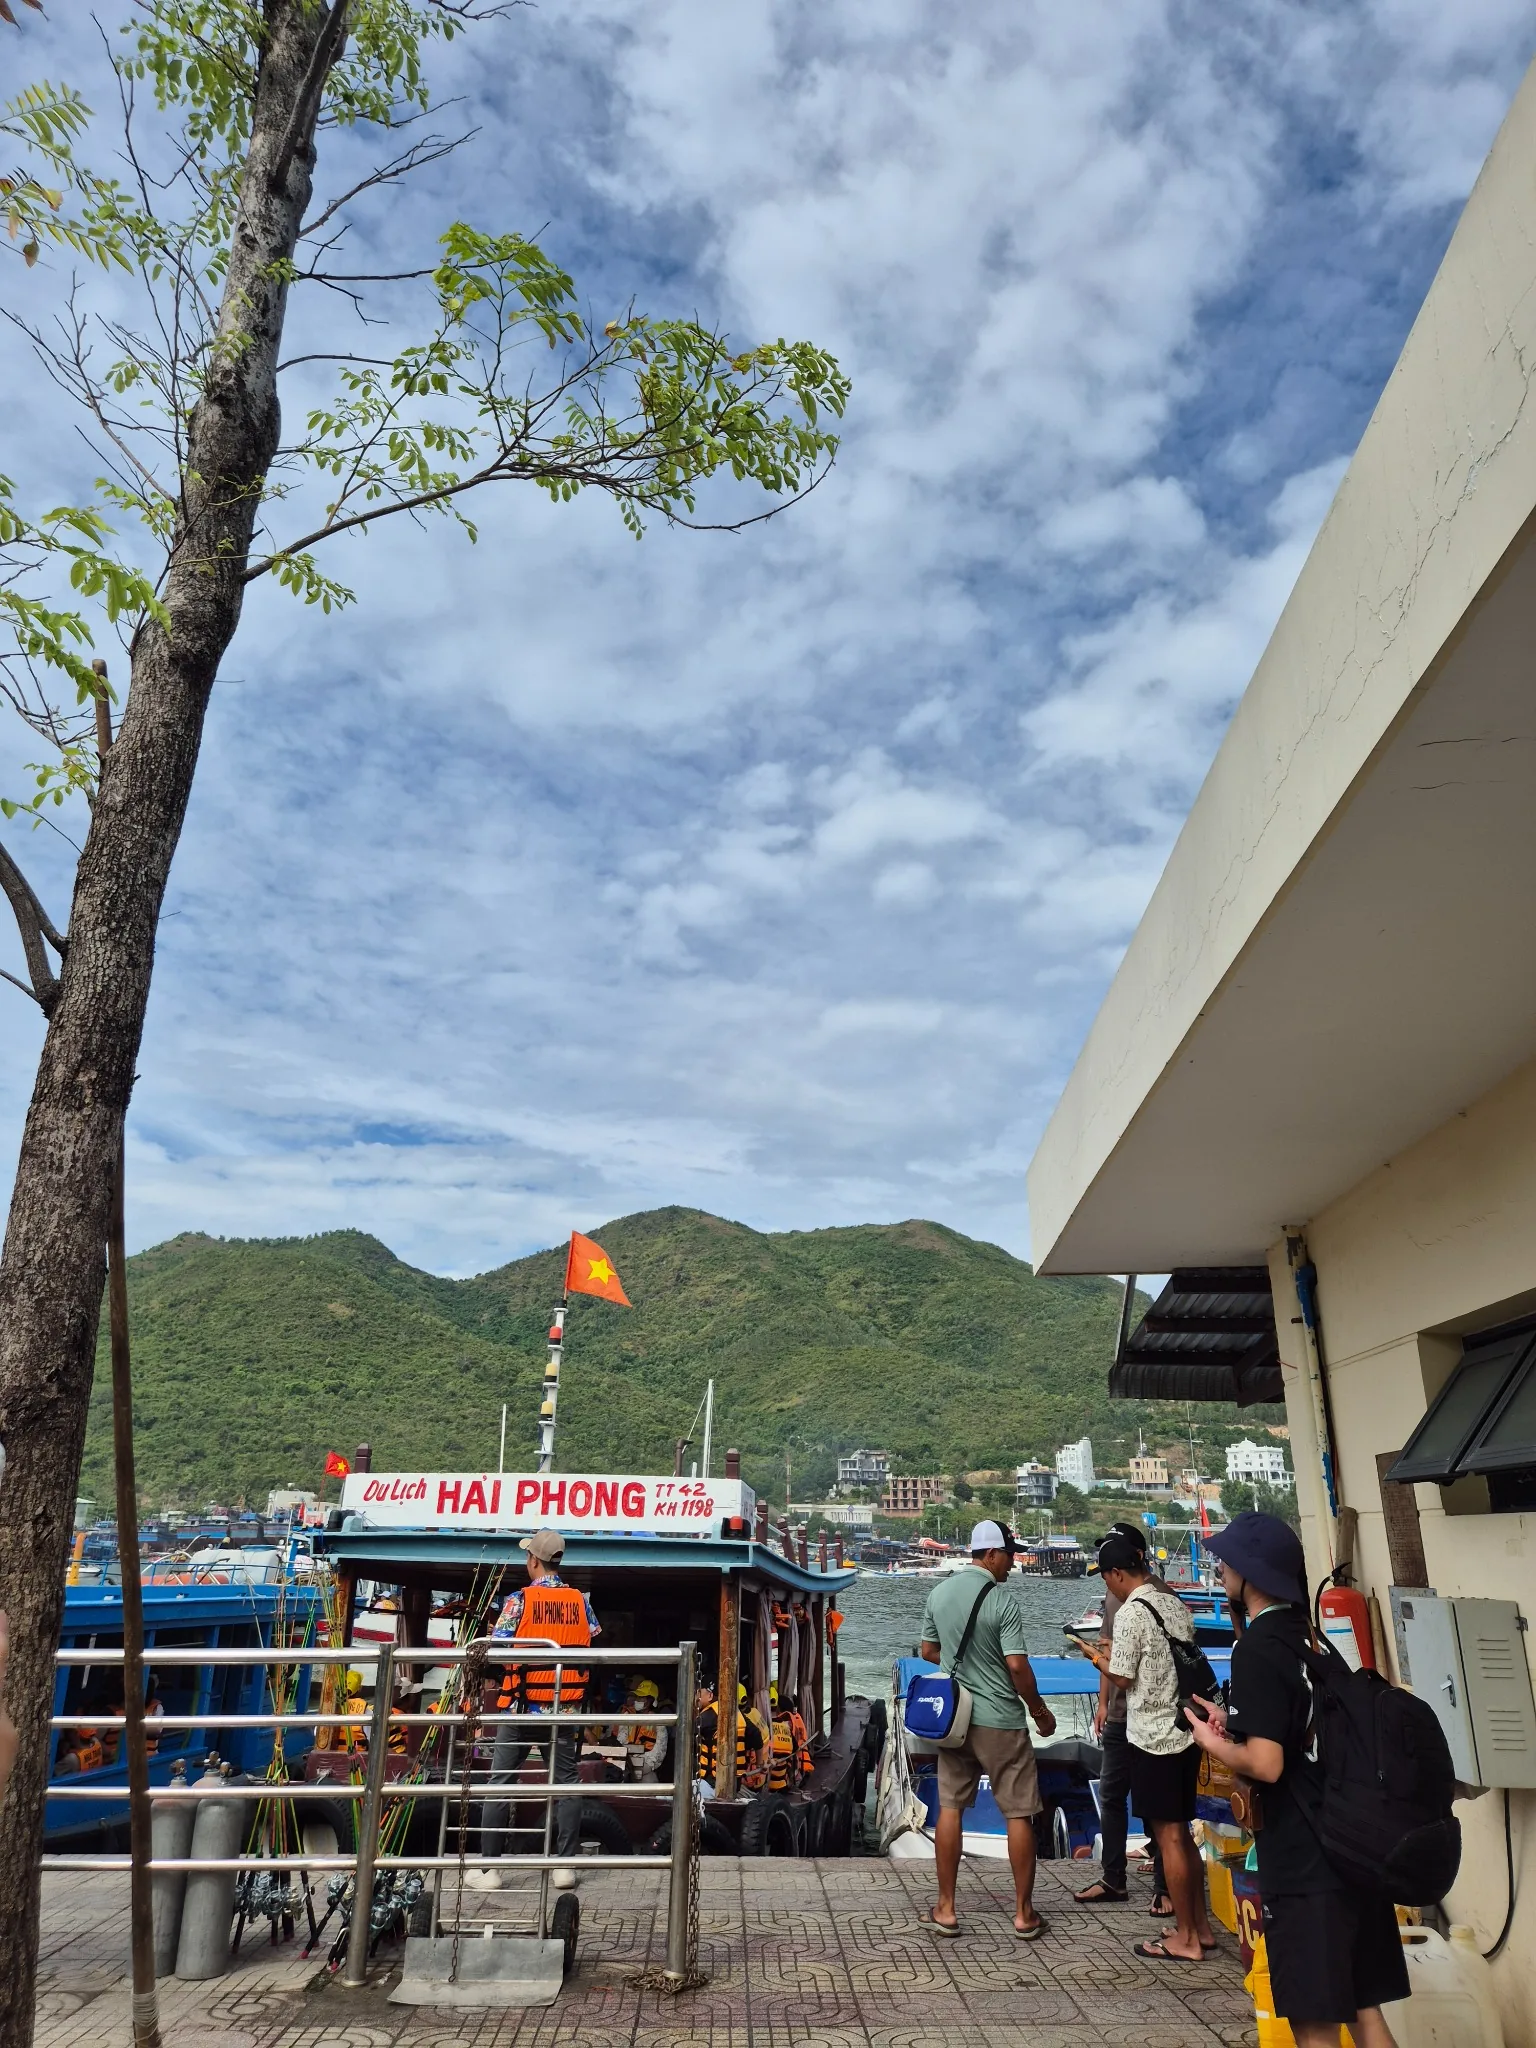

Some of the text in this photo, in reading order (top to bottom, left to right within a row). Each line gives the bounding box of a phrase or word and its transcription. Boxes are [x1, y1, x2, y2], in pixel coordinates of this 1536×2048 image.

[363, 1475, 646, 1518] Du Lịch HẢI PHONG
[656, 1482, 707, 1498] TT 42
[654, 1498, 714, 1517] KH 1198
[544, 1601, 564, 1624] PHONG
[566, 1602, 580, 1625] 1198
